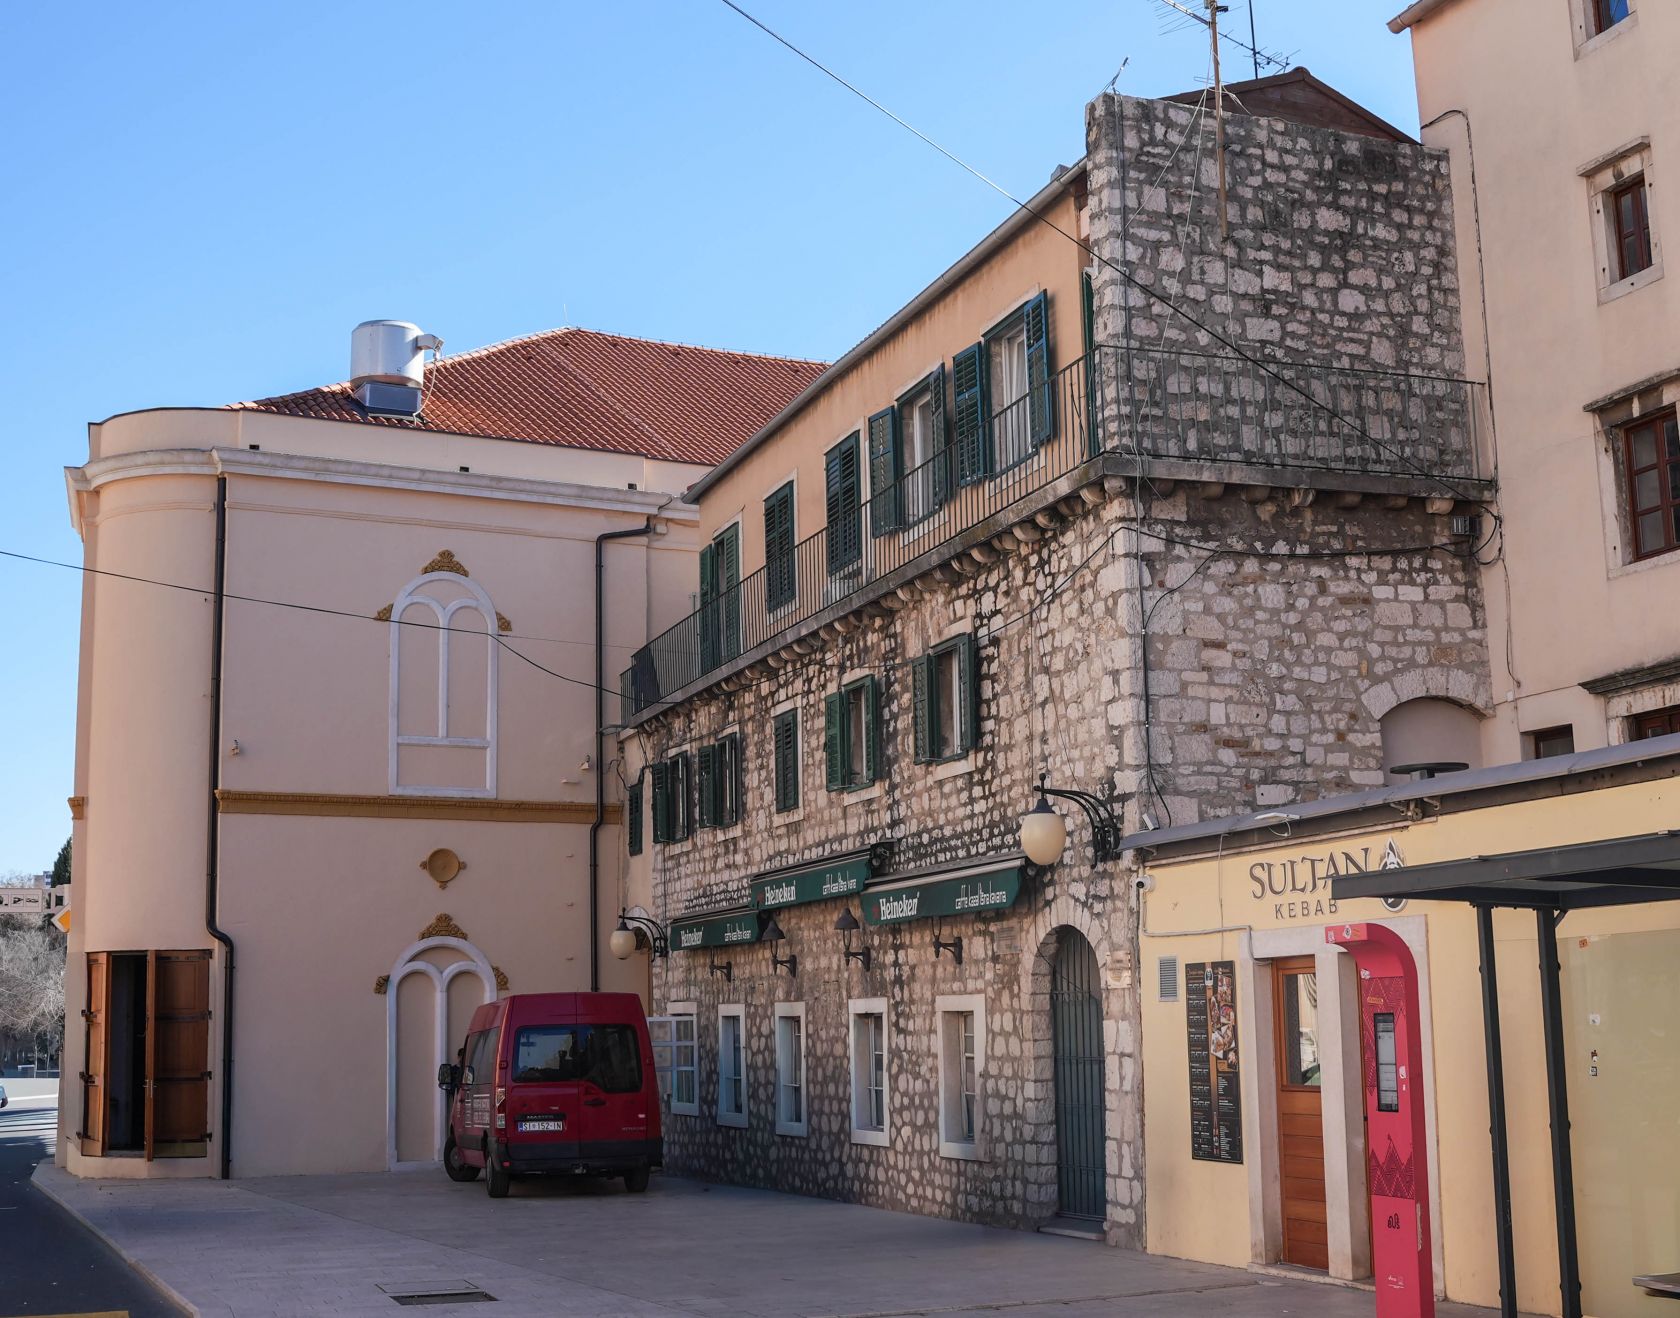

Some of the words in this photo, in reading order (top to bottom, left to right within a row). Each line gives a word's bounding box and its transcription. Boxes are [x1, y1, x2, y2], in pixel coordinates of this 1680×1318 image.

[1249, 847, 1370, 899] SULTAN
[764, 880, 796, 905] Heineken
[879, 891, 920, 920] Heineken
[1274, 899, 1338, 920] KEBAB
[680, 925, 704, 948] Heineken
